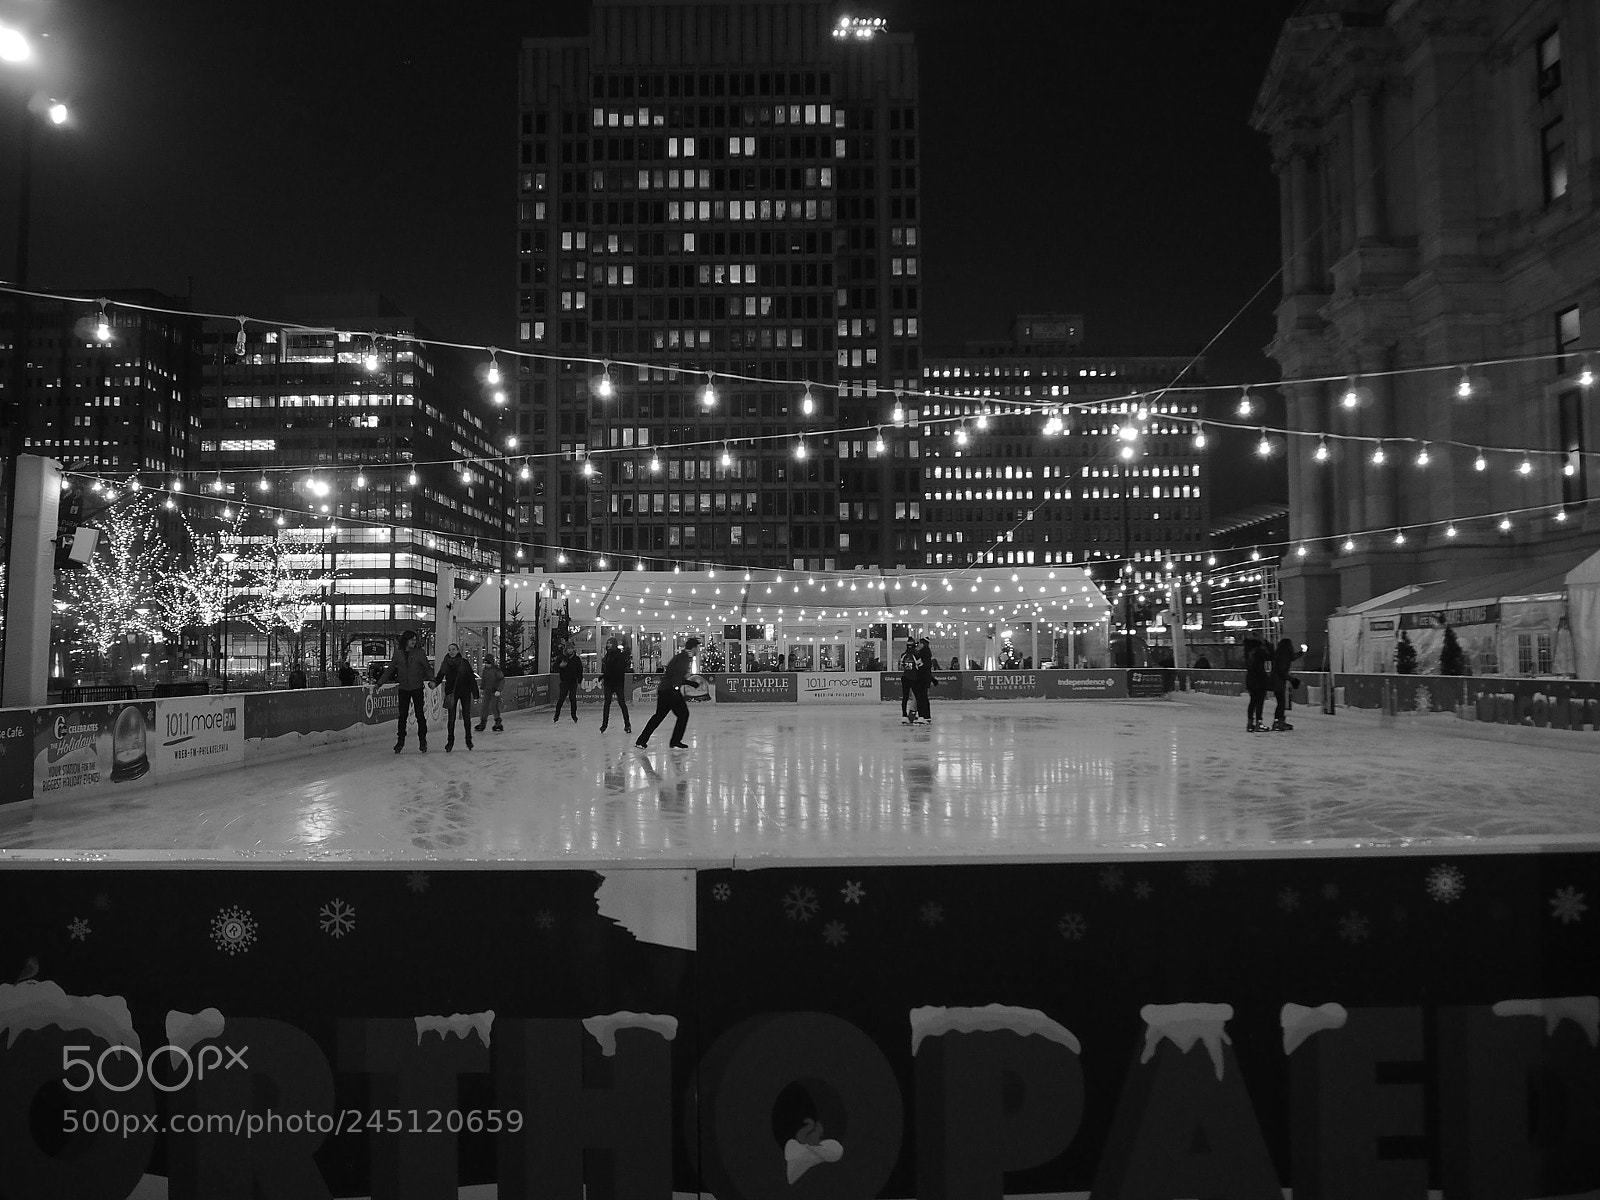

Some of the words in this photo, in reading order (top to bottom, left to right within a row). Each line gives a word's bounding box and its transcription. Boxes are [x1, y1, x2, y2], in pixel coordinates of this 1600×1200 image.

[740, 678, 789, 688] TEMPLE
[805, 678, 827, 689] 101.1
[828, 678, 859, 687] more
[859, 678, 872, 688] FM
[988, 675, 1036, 686] TEMPLE
[1057, 678, 1106, 687] Independence
[68, 723, 99, 734] CELEBRATES
[165, 712, 189, 738] 101.1
[191, 712, 223, 731] more
[223, 709, 236, 729] FM
[57, 734, 97, 755] Holidays
